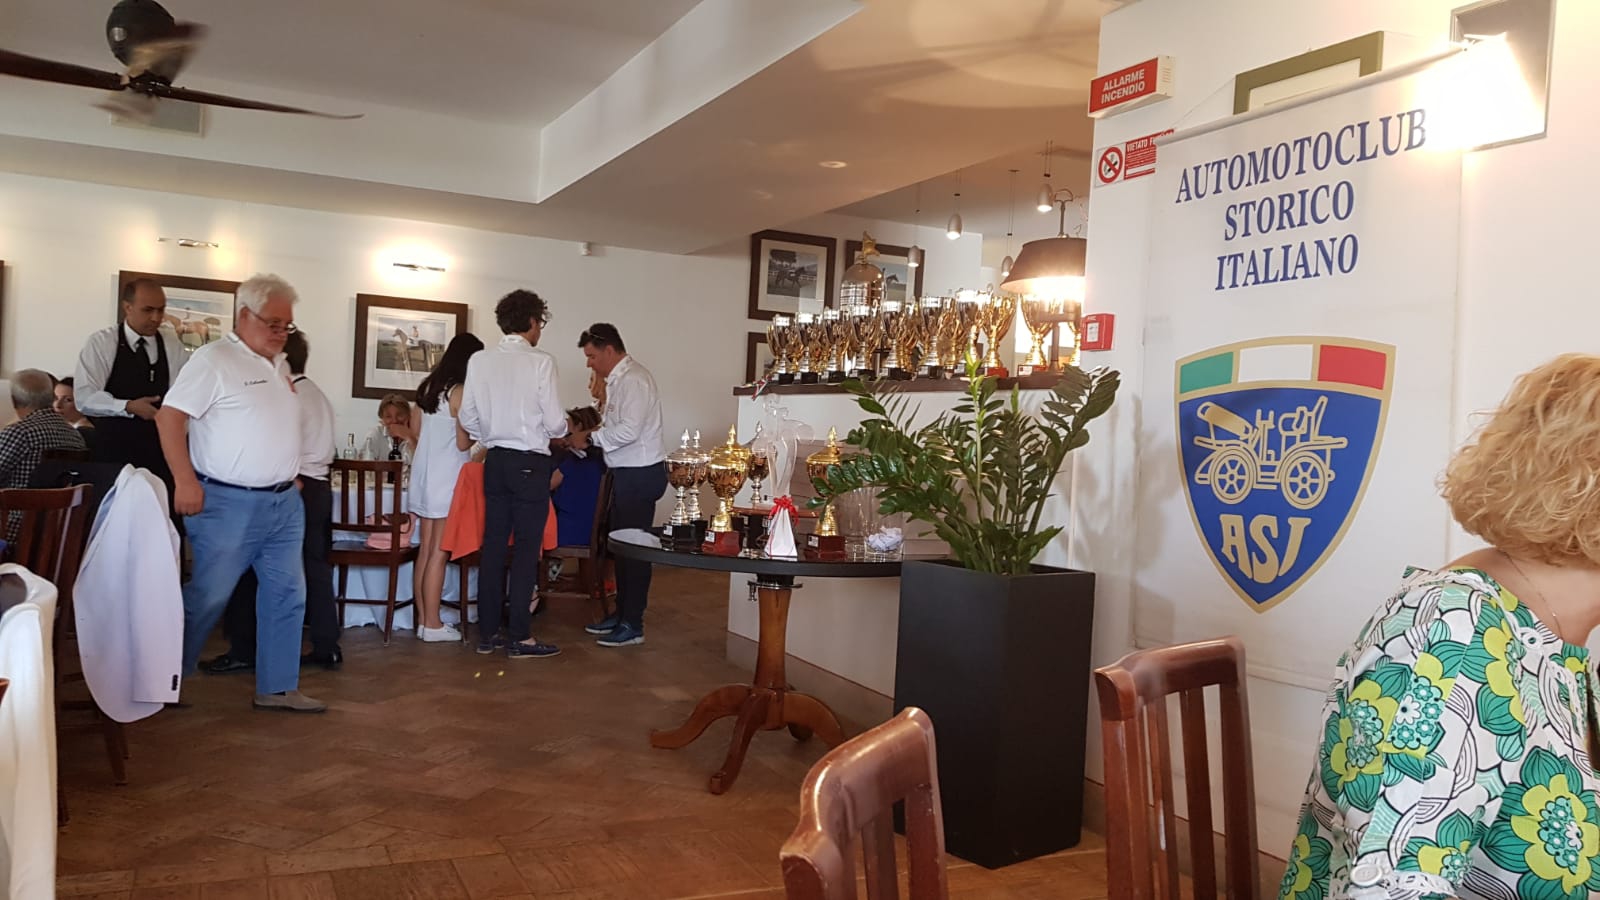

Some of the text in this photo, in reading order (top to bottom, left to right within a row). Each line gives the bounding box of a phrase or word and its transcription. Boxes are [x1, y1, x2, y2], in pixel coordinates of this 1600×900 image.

[1101, 82, 1145, 104] INCENDIO
[1103, 69, 1145, 92] ALLARME
[1126, 139, 1148, 153] VIETATO
[1175, 108, 1426, 204] AUTOMOTOCLUB
[1224, 180, 1355, 241] STORICO
[1215, 234, 1359, 291] ITALIANO
